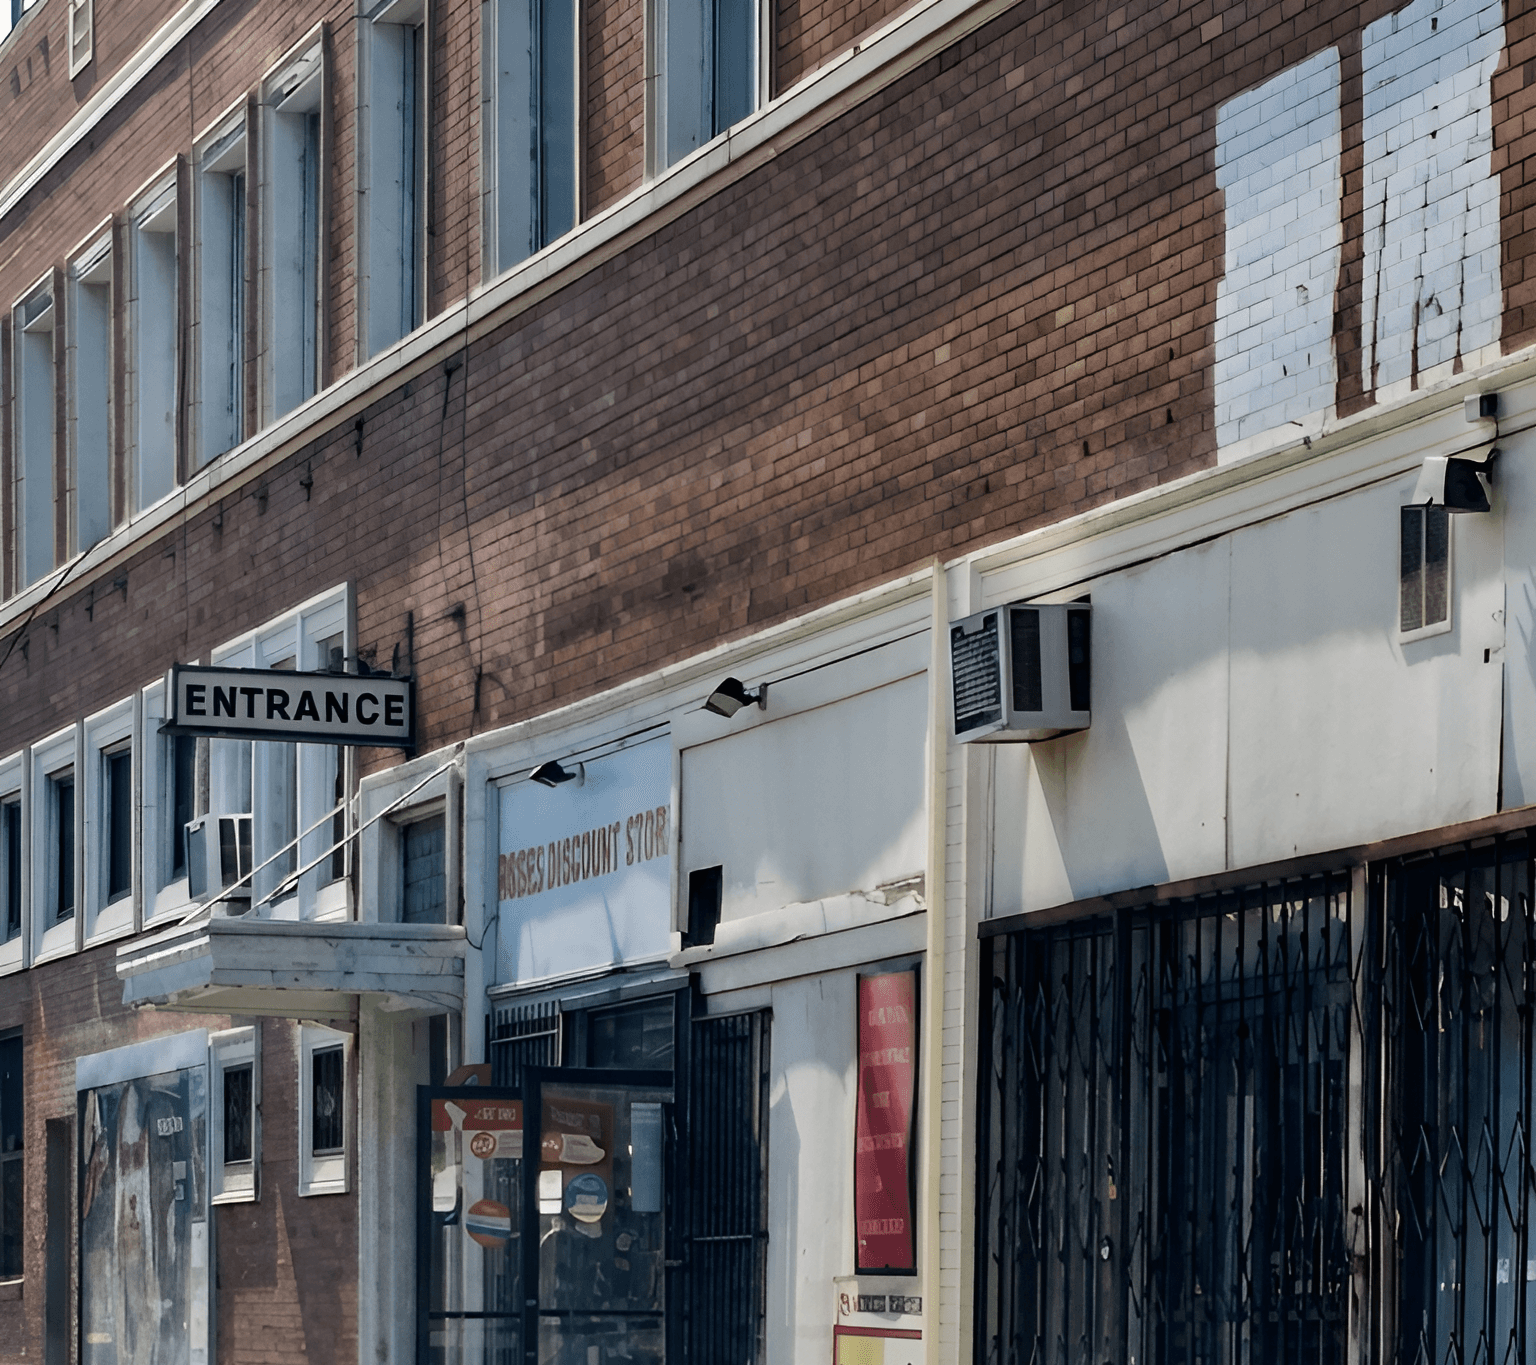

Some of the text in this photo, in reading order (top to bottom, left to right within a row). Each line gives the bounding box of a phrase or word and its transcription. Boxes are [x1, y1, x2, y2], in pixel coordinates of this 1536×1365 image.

[185, 683, 405, 727] ENTRANCE
[547, 821, 621, 890] DISCOUNT
[626, 804, 671, 866] STOR
